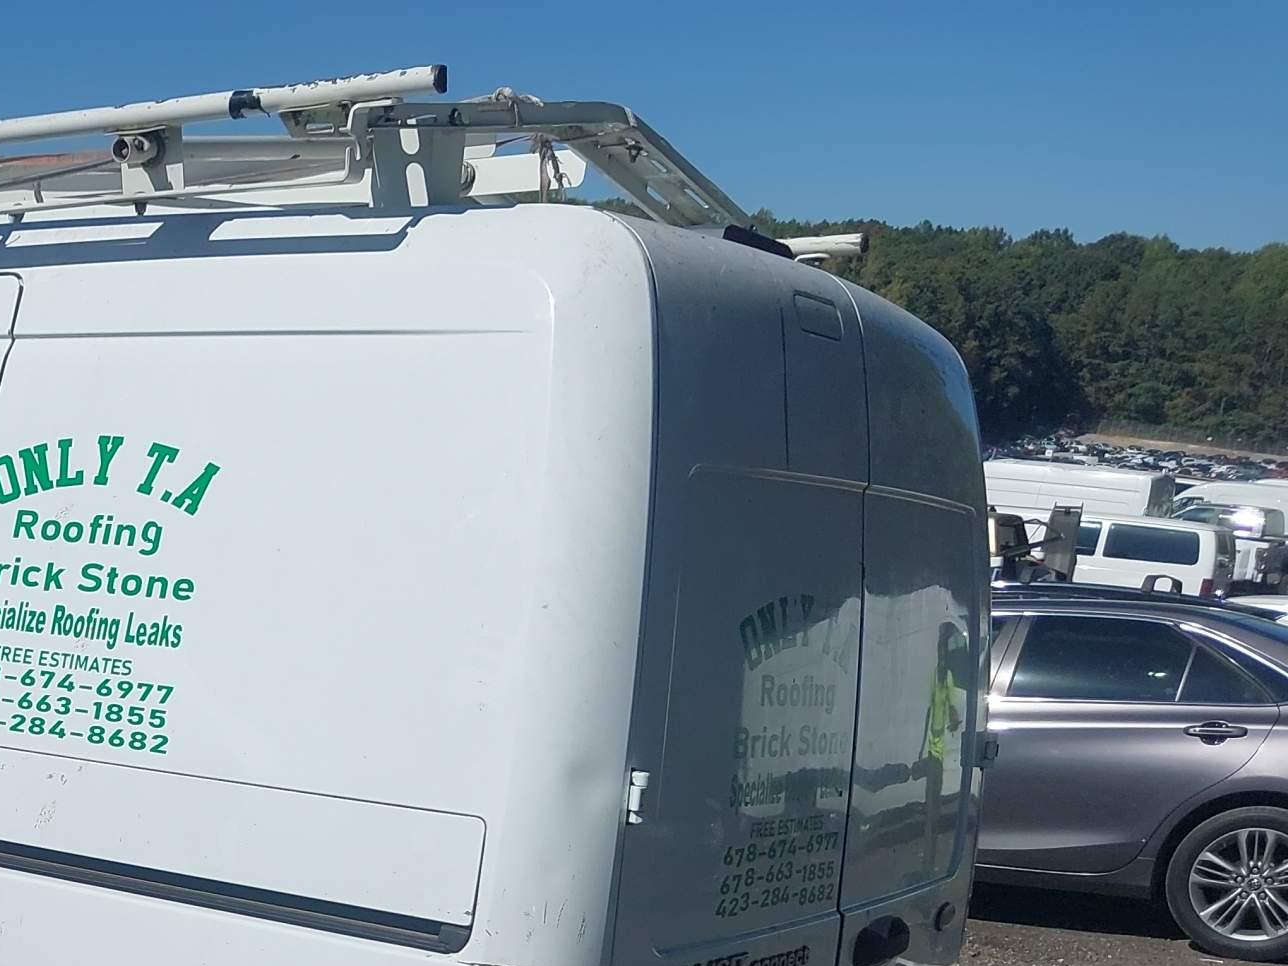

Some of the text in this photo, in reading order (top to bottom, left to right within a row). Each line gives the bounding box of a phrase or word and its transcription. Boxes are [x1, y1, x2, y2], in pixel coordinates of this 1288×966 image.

[136, 442, 221, 516] T.A
[12, 509, 163, 556] Roofing
[77, 563, 195, 601] Stone
[50, 605, 120, 650] Roofing
[124, 612, 183, 648] Leaks
[37, 651, 133, 676] ESTIMATES
[760, 674, 837, 714] Roofing
[735, 727, 792, 760] Brick
[750, 819, 776, 840] FREE
[723, 831, 840, 868] 678-674-6977
[720, 861, 835, 895] 678-663-1855
[715, 882, 835, 920] 423-284-8682
